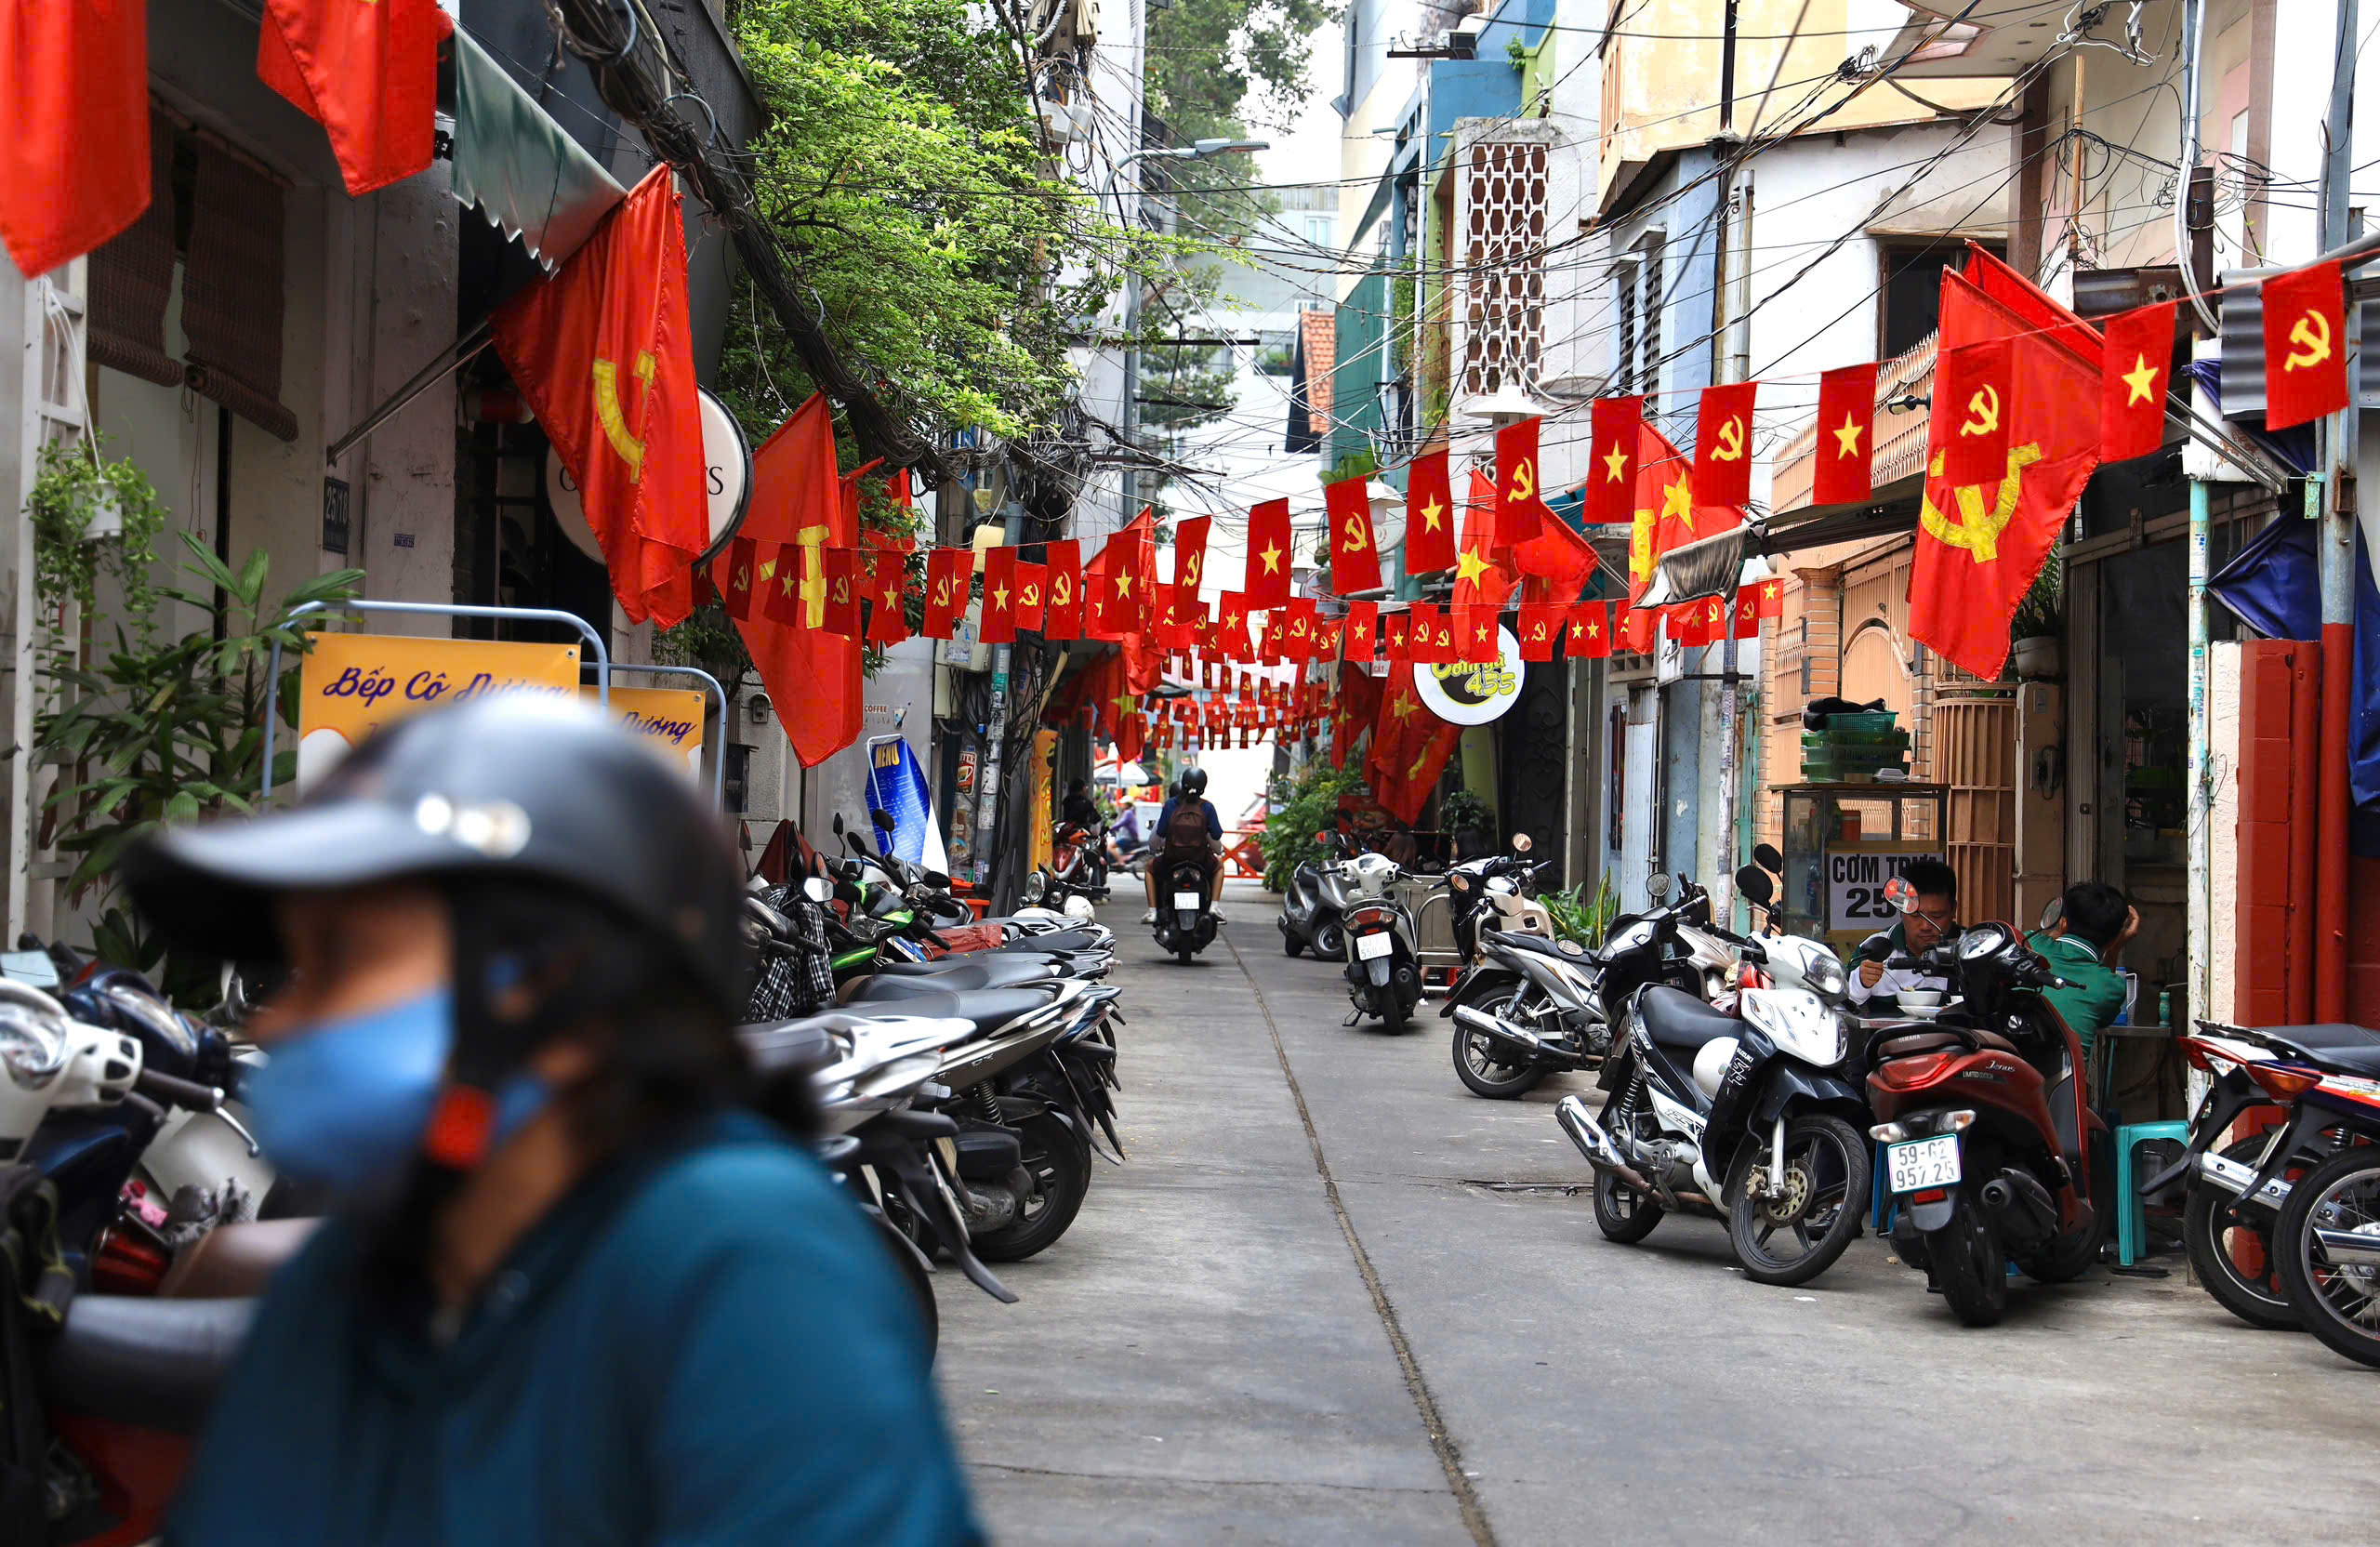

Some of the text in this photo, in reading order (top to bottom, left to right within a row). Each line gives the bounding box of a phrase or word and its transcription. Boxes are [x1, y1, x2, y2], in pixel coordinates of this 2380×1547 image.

[323, 666, 396, 707] Bếp
[404, 669, 452, 702] Cô
[1464, 670, 1515, 697] 455
[864, 705, 888, 714] COFFEE
[875, 742, 901, 770] MENU
[1832, 853, 1880, 884] CƠM
[1897, 1034, 1921, 1043] YAMAHA
[1736, 1046, 1754, 1064] SUZUKI
